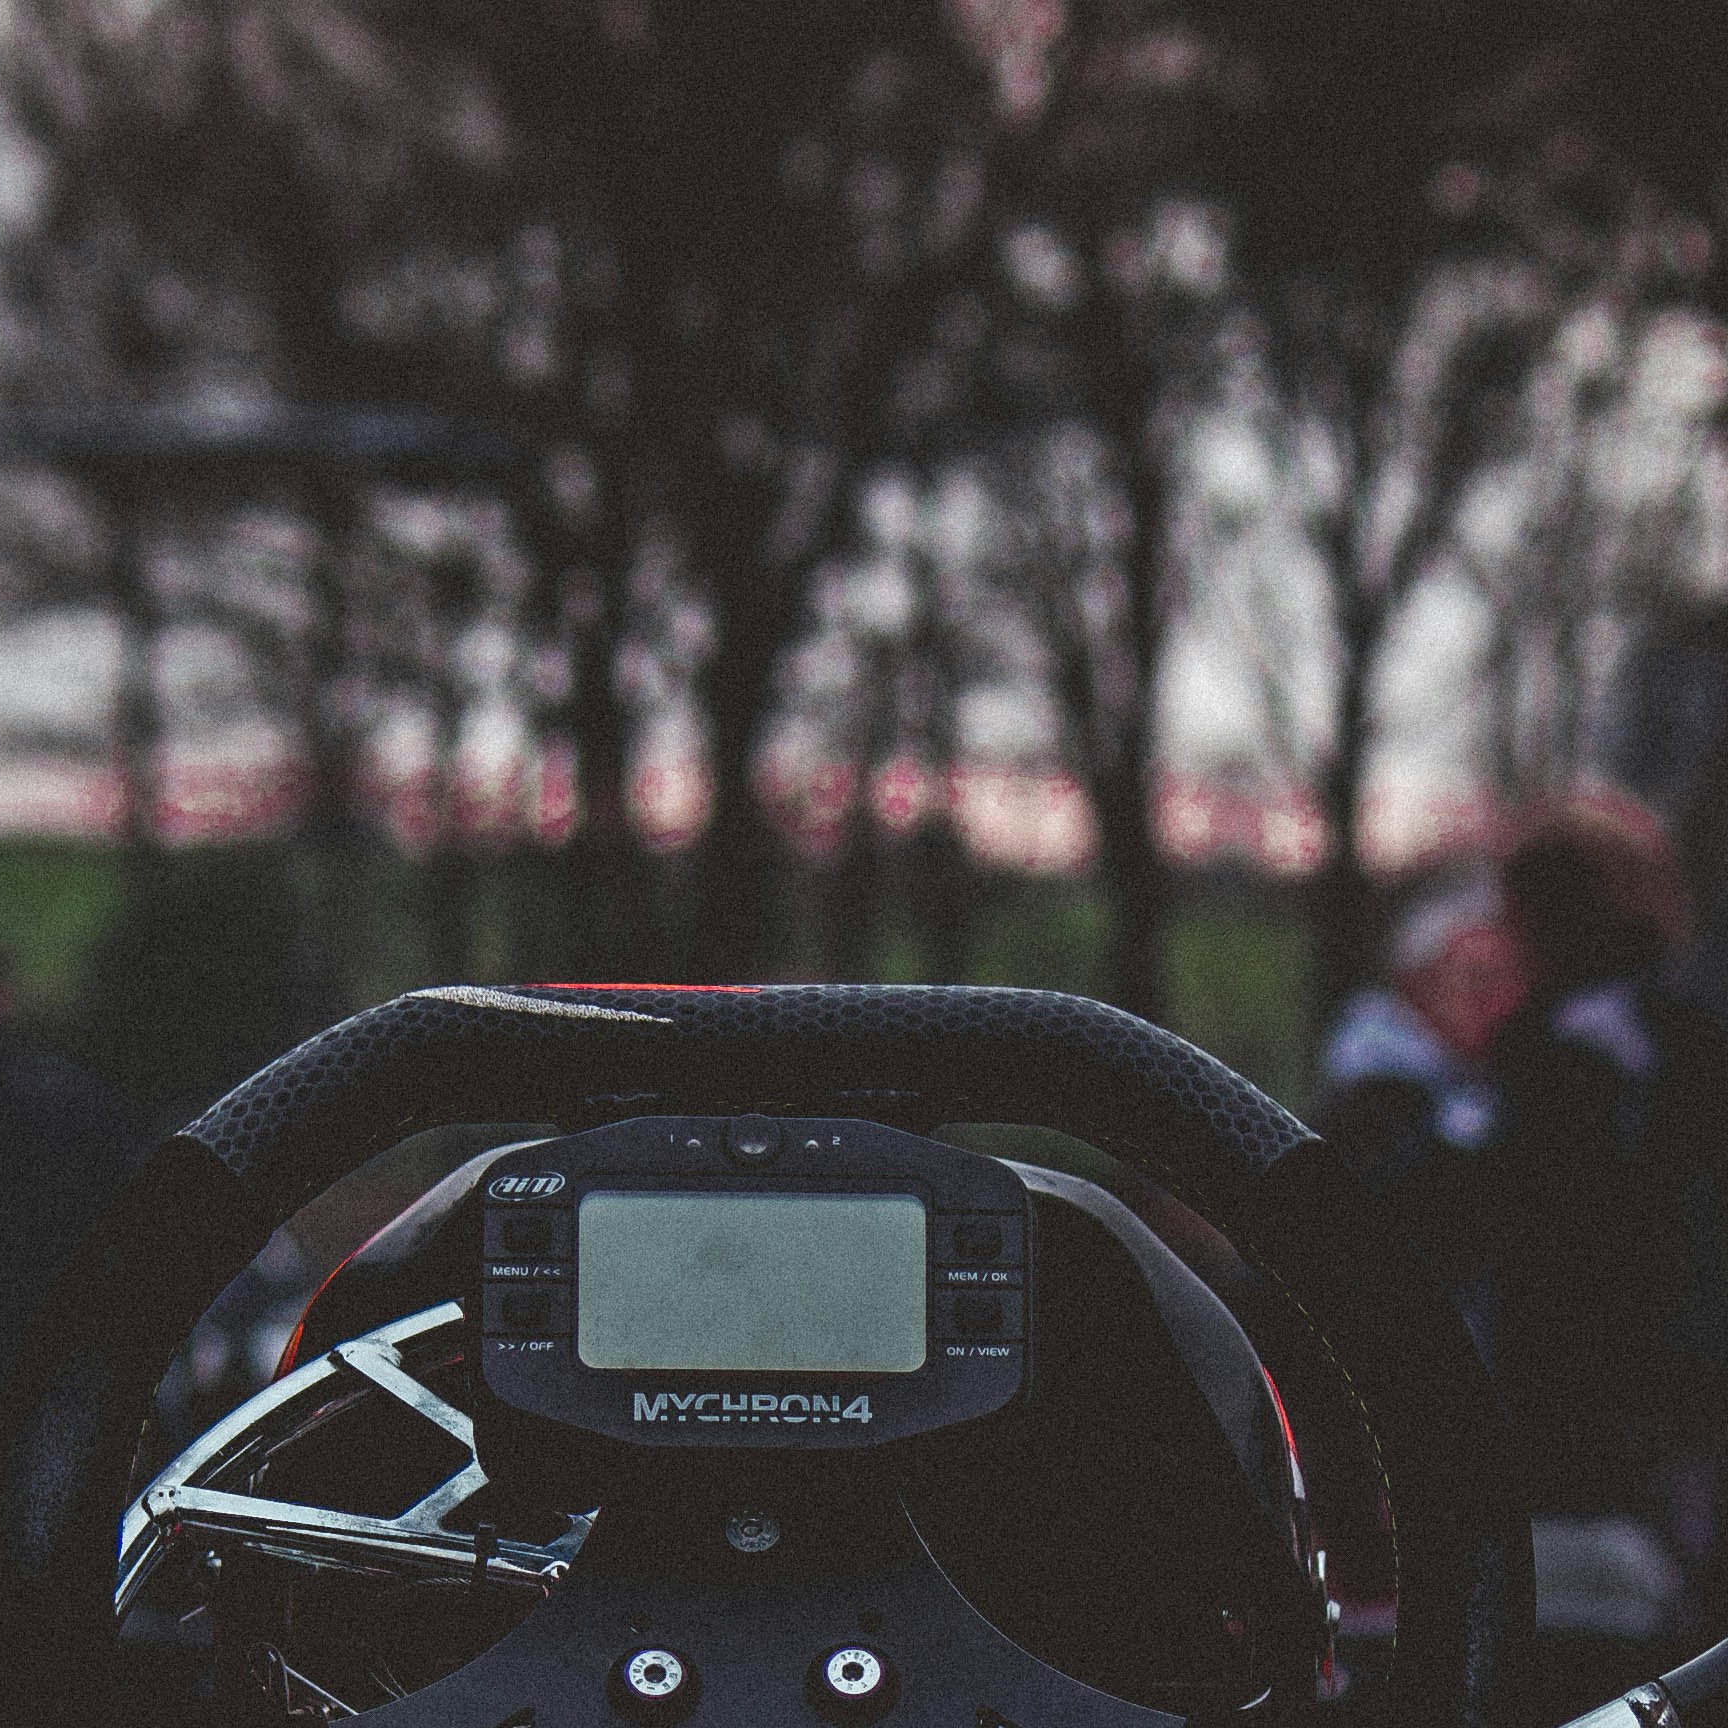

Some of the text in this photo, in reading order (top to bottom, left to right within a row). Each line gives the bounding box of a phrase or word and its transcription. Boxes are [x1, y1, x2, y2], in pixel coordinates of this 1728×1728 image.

[832, 1136, 841, 1146] 2
[492, 1266, 529, 1276] MENU
[948, 1271, 978, 1281] MEM
[991, 1272, 1008, 1281] OK
[529, 1342, 555, 1352] OFF
[946, 1346, 965, 1356] ON
[977, 1347, 1010, 1357] VIEW
[633, 1392, 873, 1424] MYCHRON4
